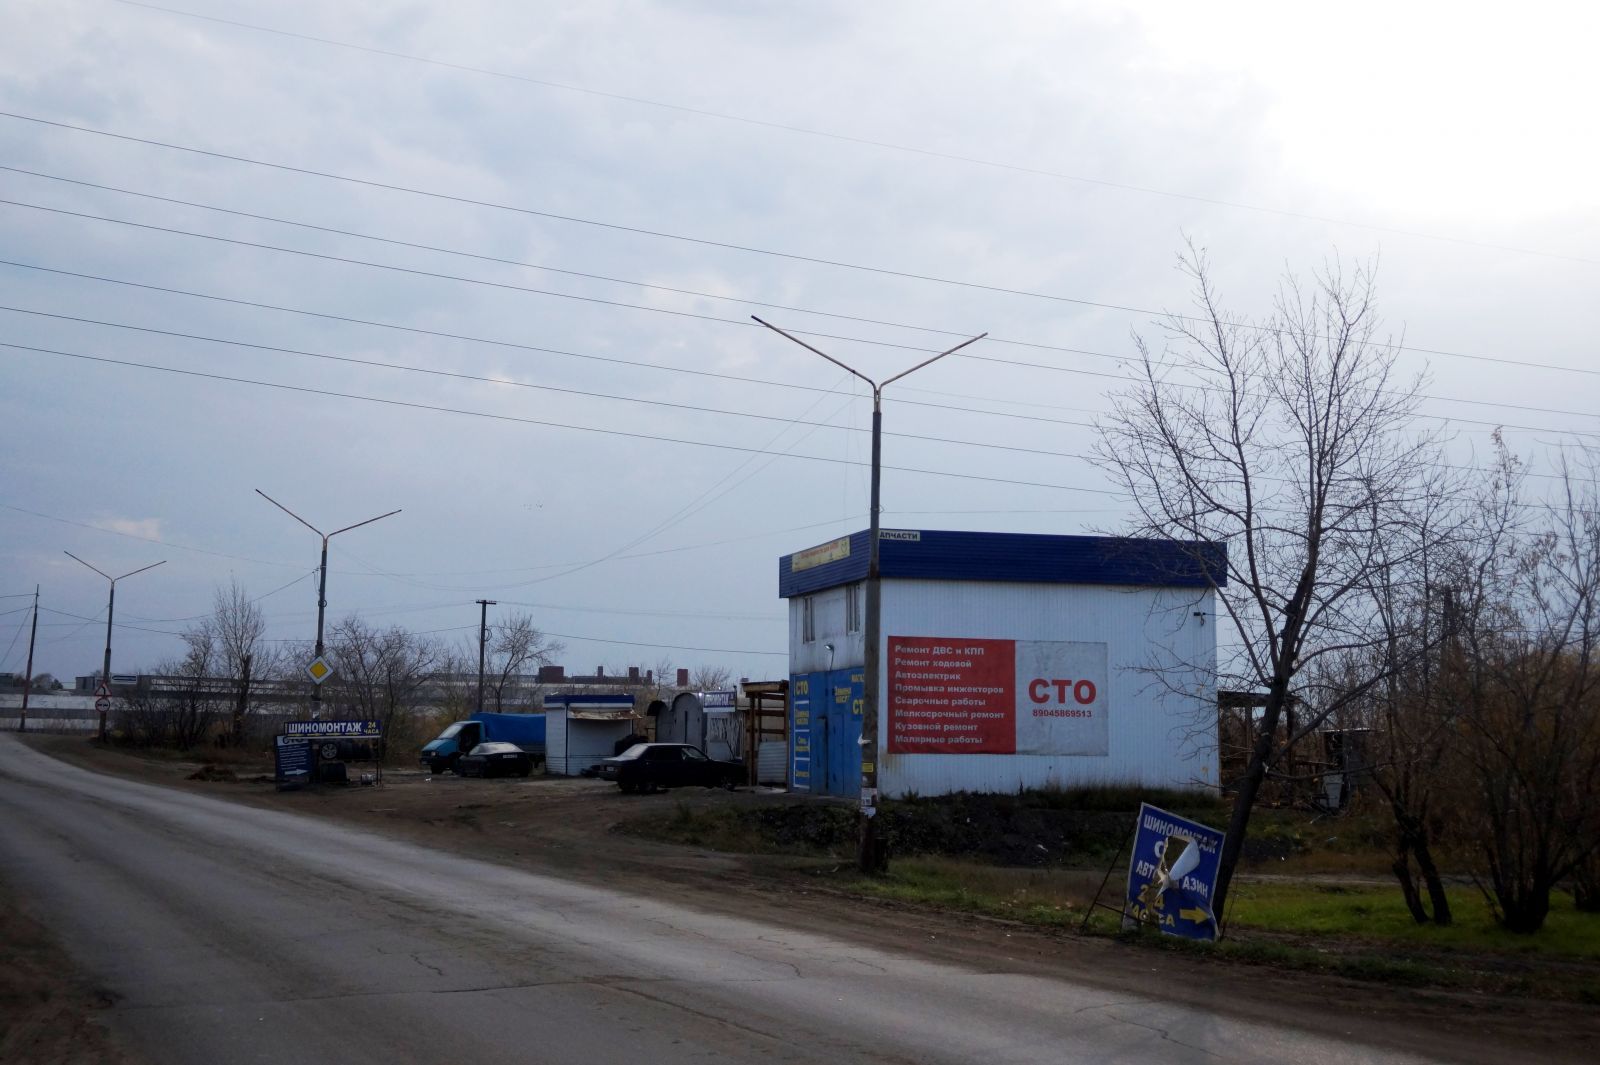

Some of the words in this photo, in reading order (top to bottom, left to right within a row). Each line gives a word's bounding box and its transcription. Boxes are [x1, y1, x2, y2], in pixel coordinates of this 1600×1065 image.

[879, 531, 918, 540] АПЧАСТИ
[895, 644, 930, 655] Ремонт
[932, 646, 953, 656] ДВС
[964, 647, 985, 656] КПП
[895, 657, 930, 667] Ремонт
[932, 659, 972, 669] ходовой
[895, 670, 961, 681] Автоэлектрик
[796, 680, 809, 696] СТО
[895, 683, 945, 694] Промывка
[947, 686, 1004, 695] инжекторов
[1029, 678, 1097, 705] СТО
[852, 698, 864, 715] СТ
[895, 696, 949, 706] Сварочные
[951, 698, 986, 707] работы
[895, 709, 968, 719] Мелкосрочный
[970, 711, 1005, 720] ремонт
[1032, 709, 1093, 718] 89045869513
[288, 722, 362, 733] ШИНОМОНТАЖ
[367, 721, 377, 729] 24
[895, 722, 941, 732] Кузовной
[943, 724, 978, 732] ремонт
[895, 735, 946, 745] Малярные
[948, 735, 983, 745] работы
